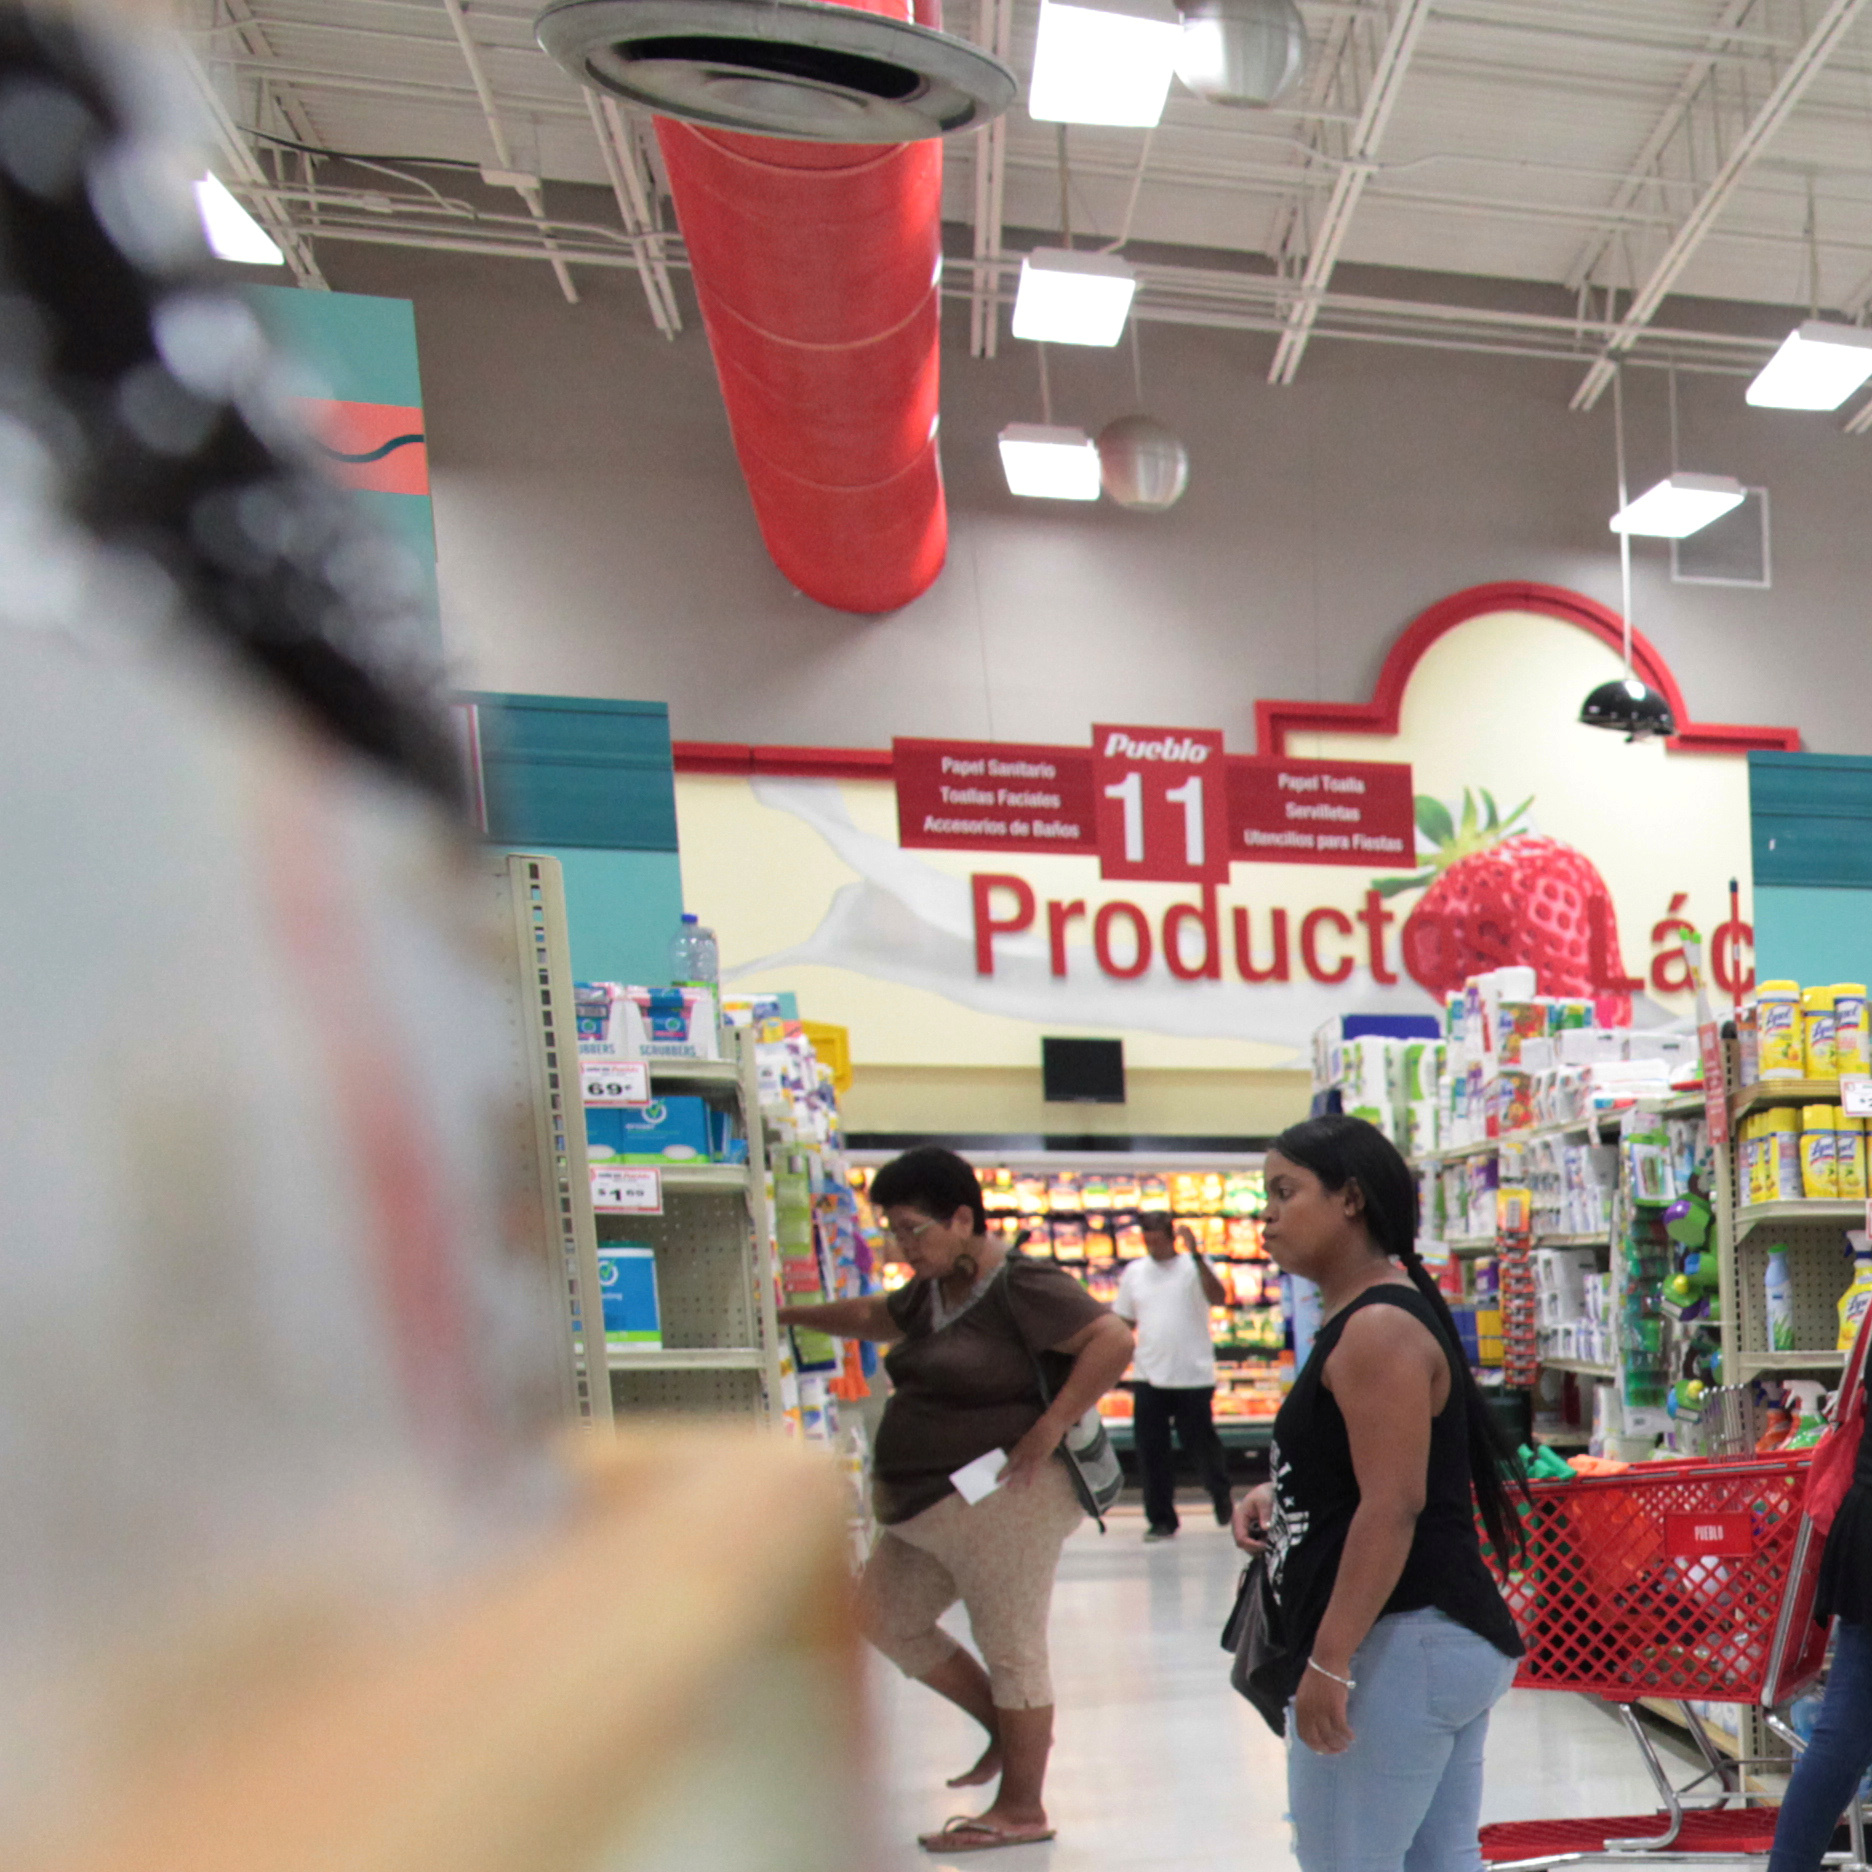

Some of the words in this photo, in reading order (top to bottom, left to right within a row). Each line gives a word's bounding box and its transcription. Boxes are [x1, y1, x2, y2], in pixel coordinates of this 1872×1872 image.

[1104, 731, 1211, 765] Pueblo
[940, 755, 985, 778] Papel
[986, 759, 1057, 781] Sanitario
[1277, 772, 1320, 795] Papel
[1321, 774, 1366, 795] Toalla
[939, 785, 995, 808] Toallas
[997, 787, 1061, 809] Faciales
[1103, 770, 1204, 867] 11
[1284, 801, 1361, 824] Servilletas
[923, 814, 1008, 838] Accesorios
[1009, 819, 1030, 838] de
[1031, 819, 1081, 841] Baños
[1316, 832, 1352, 854] para
[1353, 832, 1404, 854] Fiestas
